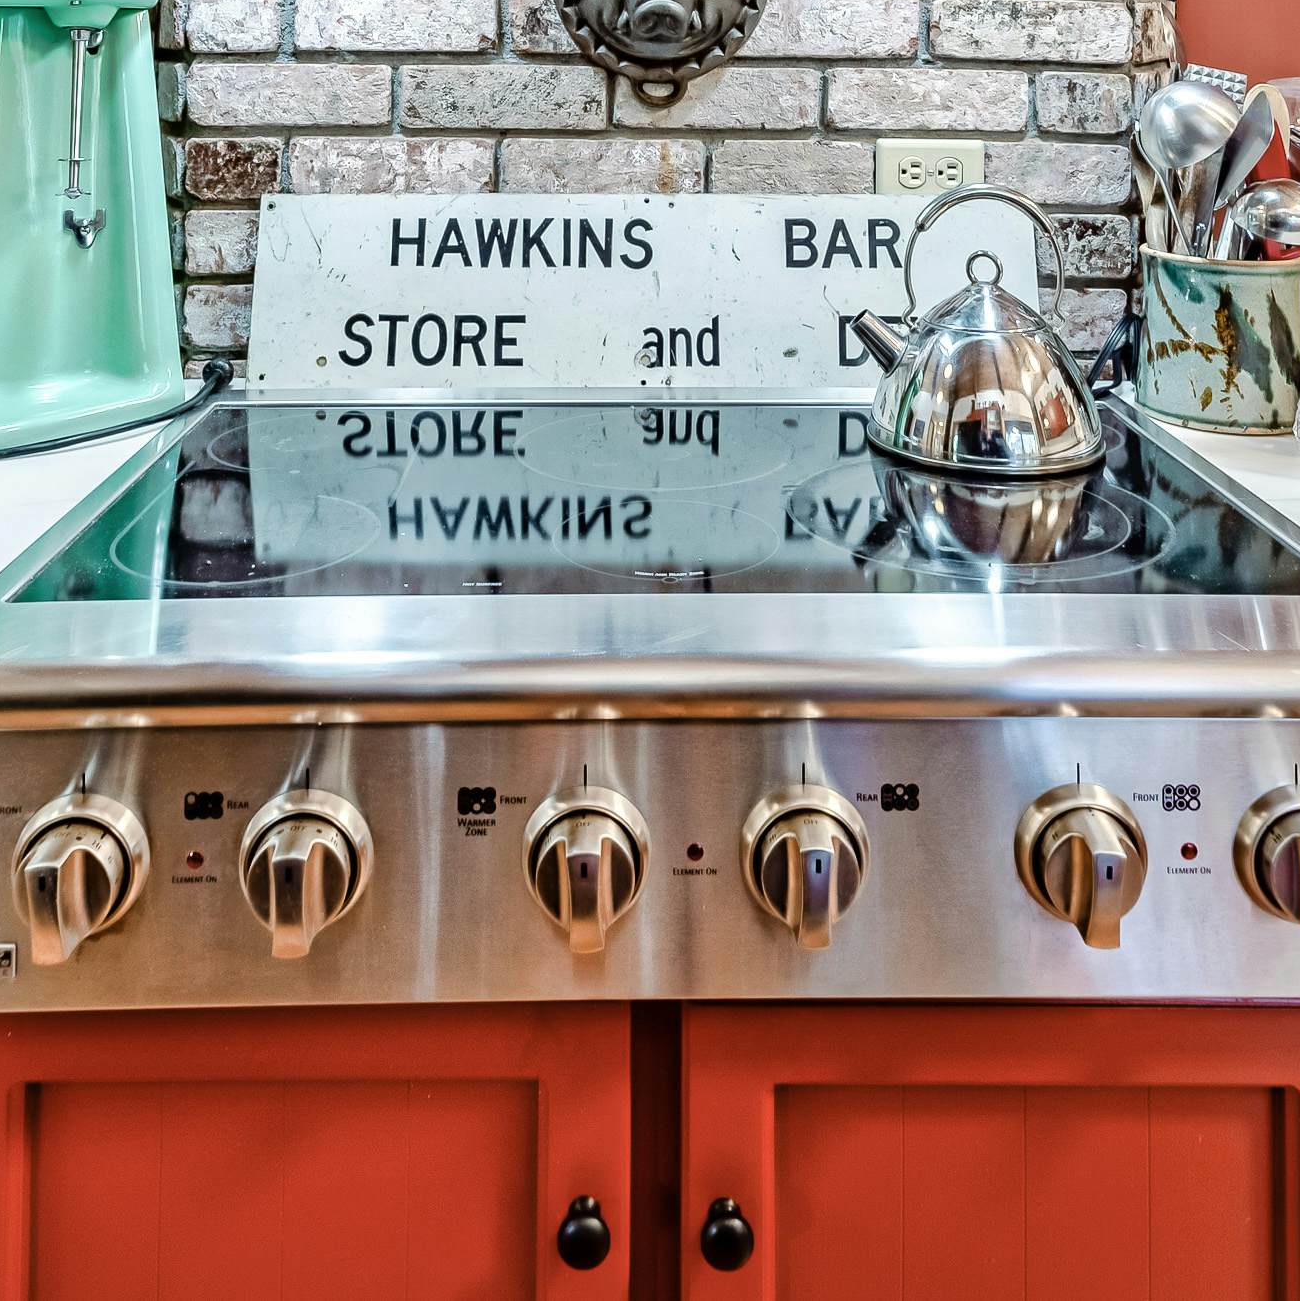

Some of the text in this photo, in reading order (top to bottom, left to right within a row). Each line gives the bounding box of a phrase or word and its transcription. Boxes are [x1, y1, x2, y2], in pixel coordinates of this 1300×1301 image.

[390, 217, 904, 270] HAWKINS BAR
[337, 313, 527, 367] STORE
[641, 314, 720, 368] and
